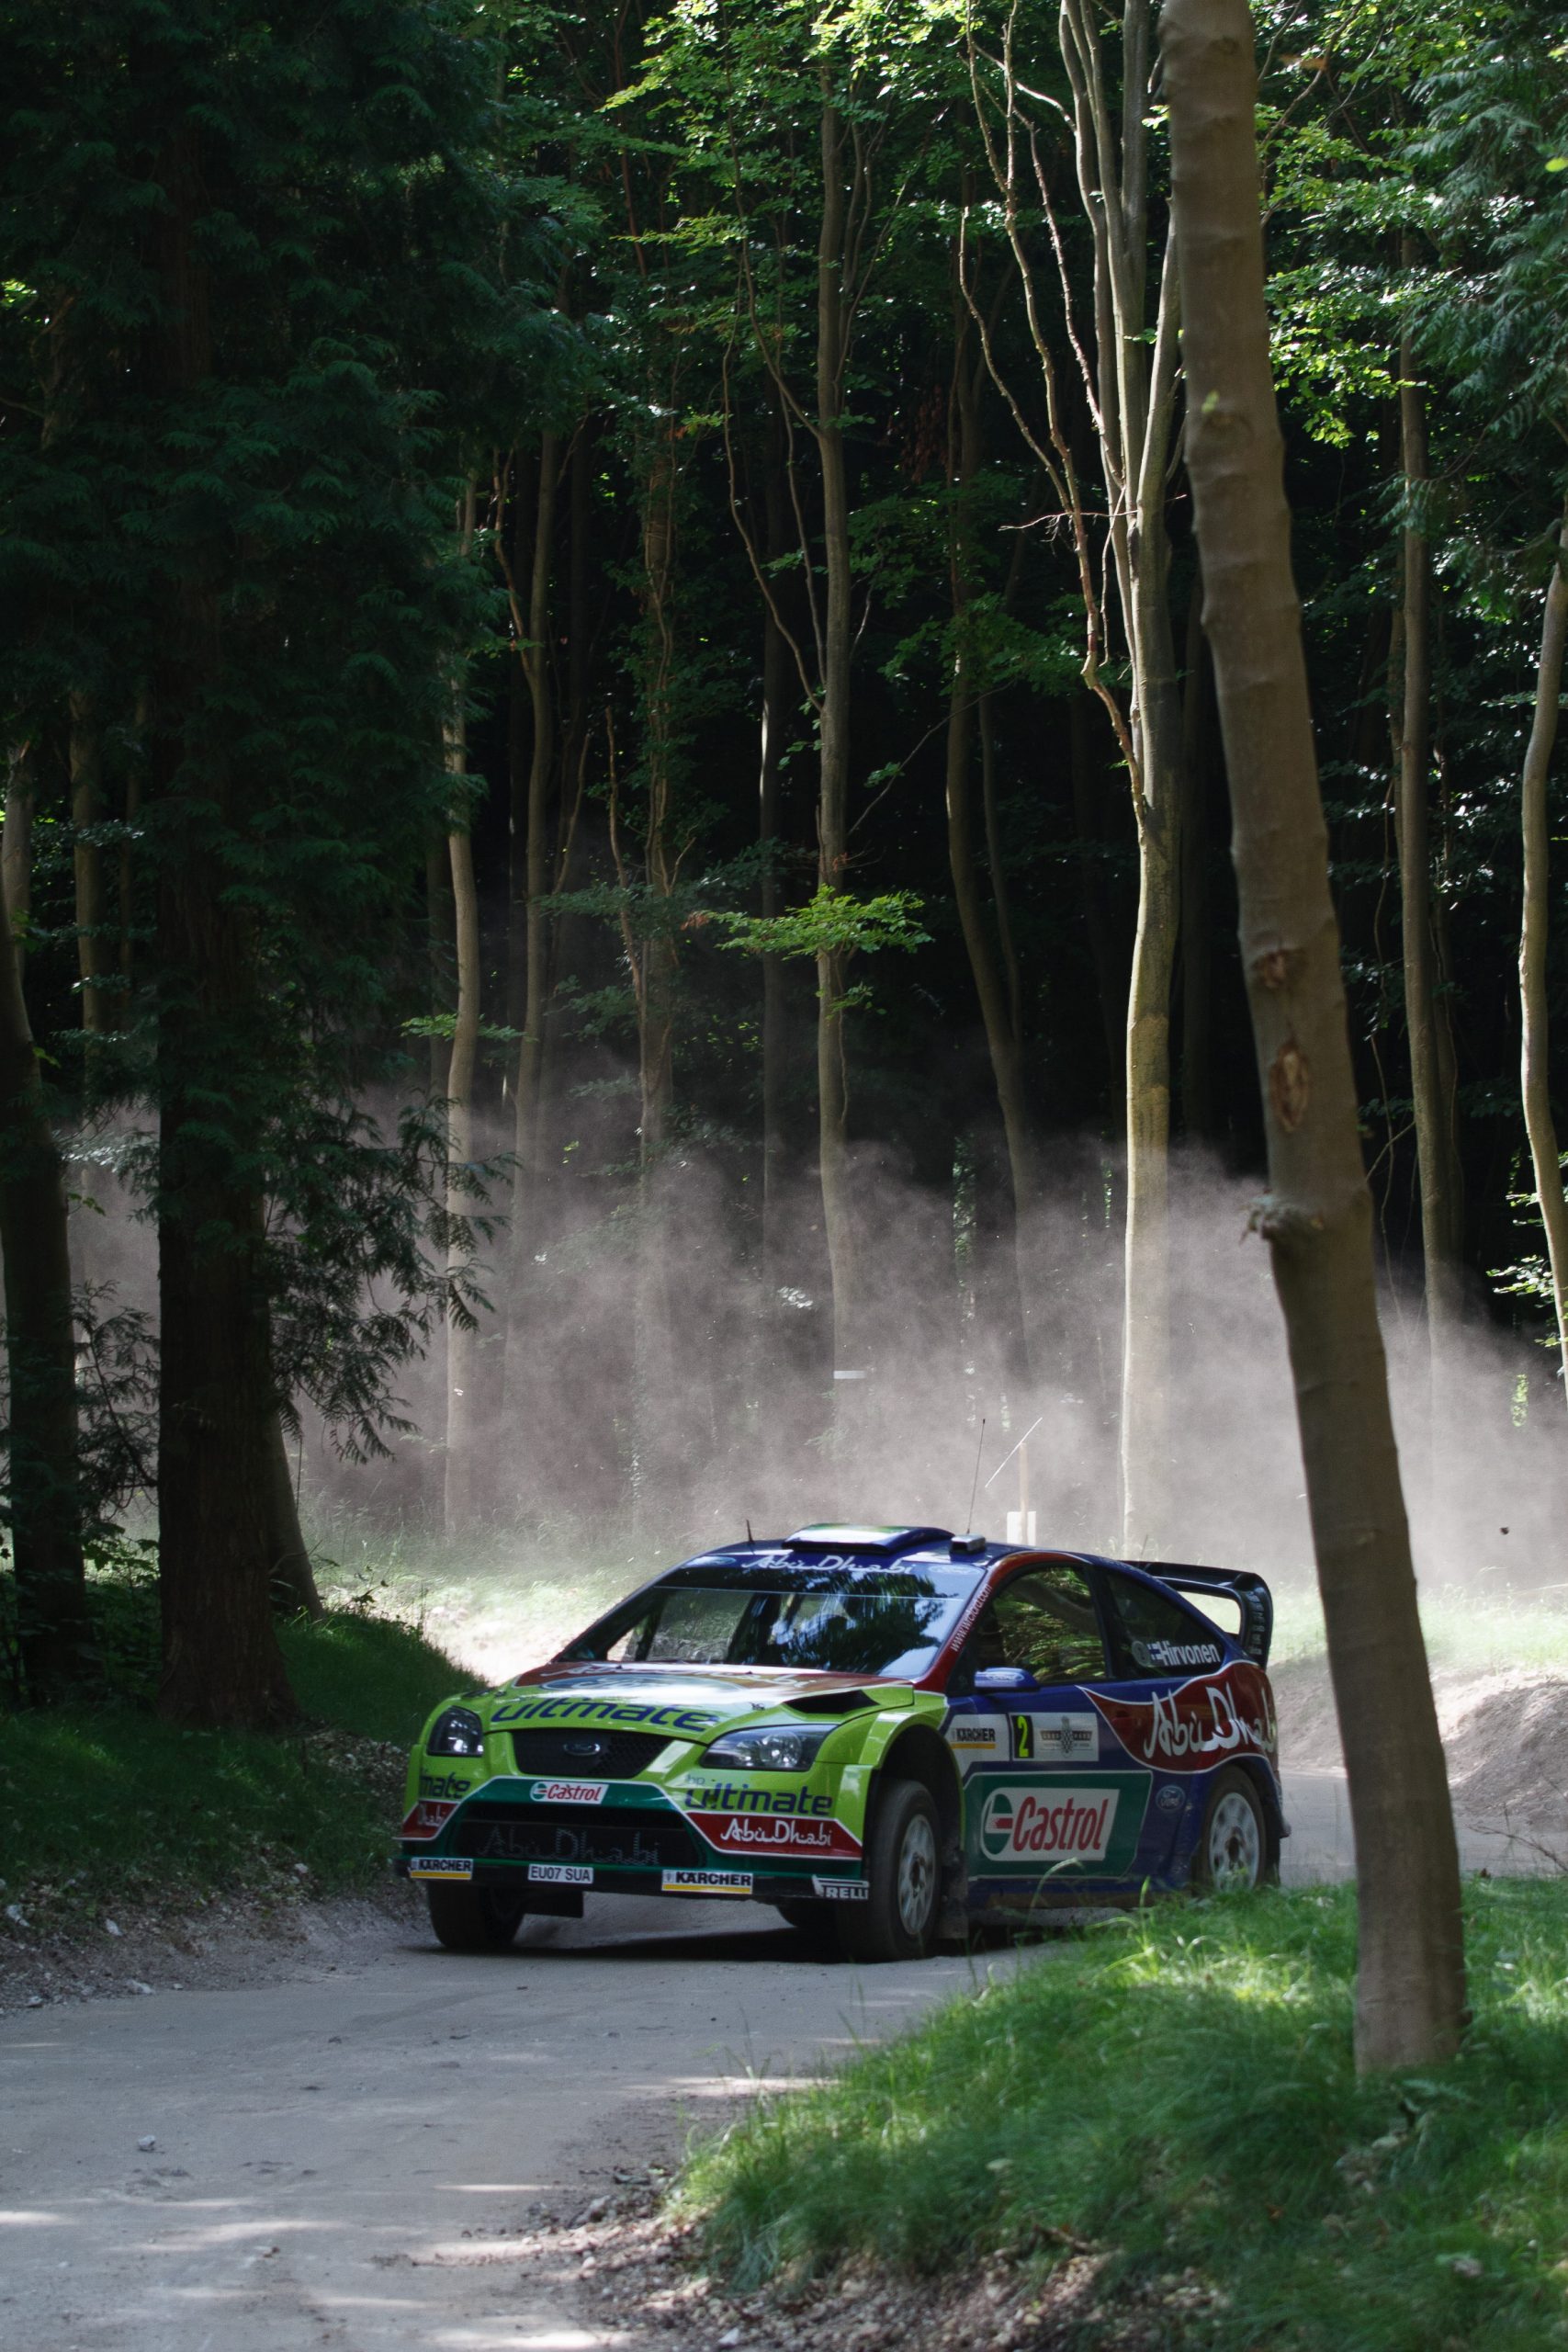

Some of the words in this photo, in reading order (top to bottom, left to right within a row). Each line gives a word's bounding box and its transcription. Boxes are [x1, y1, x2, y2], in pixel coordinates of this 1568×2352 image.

[740, 1555, 813, 1570] Abu
[816, 1555, 916, 1575] Dhabi
[1157, 1640, 1221, 1667] Hirvonen
[491, 1697, 719, 1733] ultimate
[1144, 1688, 1209, 1759] Abu
[1205, 1681, 1278, 1754] Dhab
[1017, 1715, 1029, 1757] 2
[547, 1783, 602, 1802] Castrol
[684, 1782, 834, 1816] ultimate
[720, 1817, 772, 1843] Abu
[773, 1820, 833, 1846] Dhabi
[1013, 1796, 1109, 1852] Castrol
[531, 1868, 561, 1880] EU07
[564, 1869, 591, 1882] SUA
